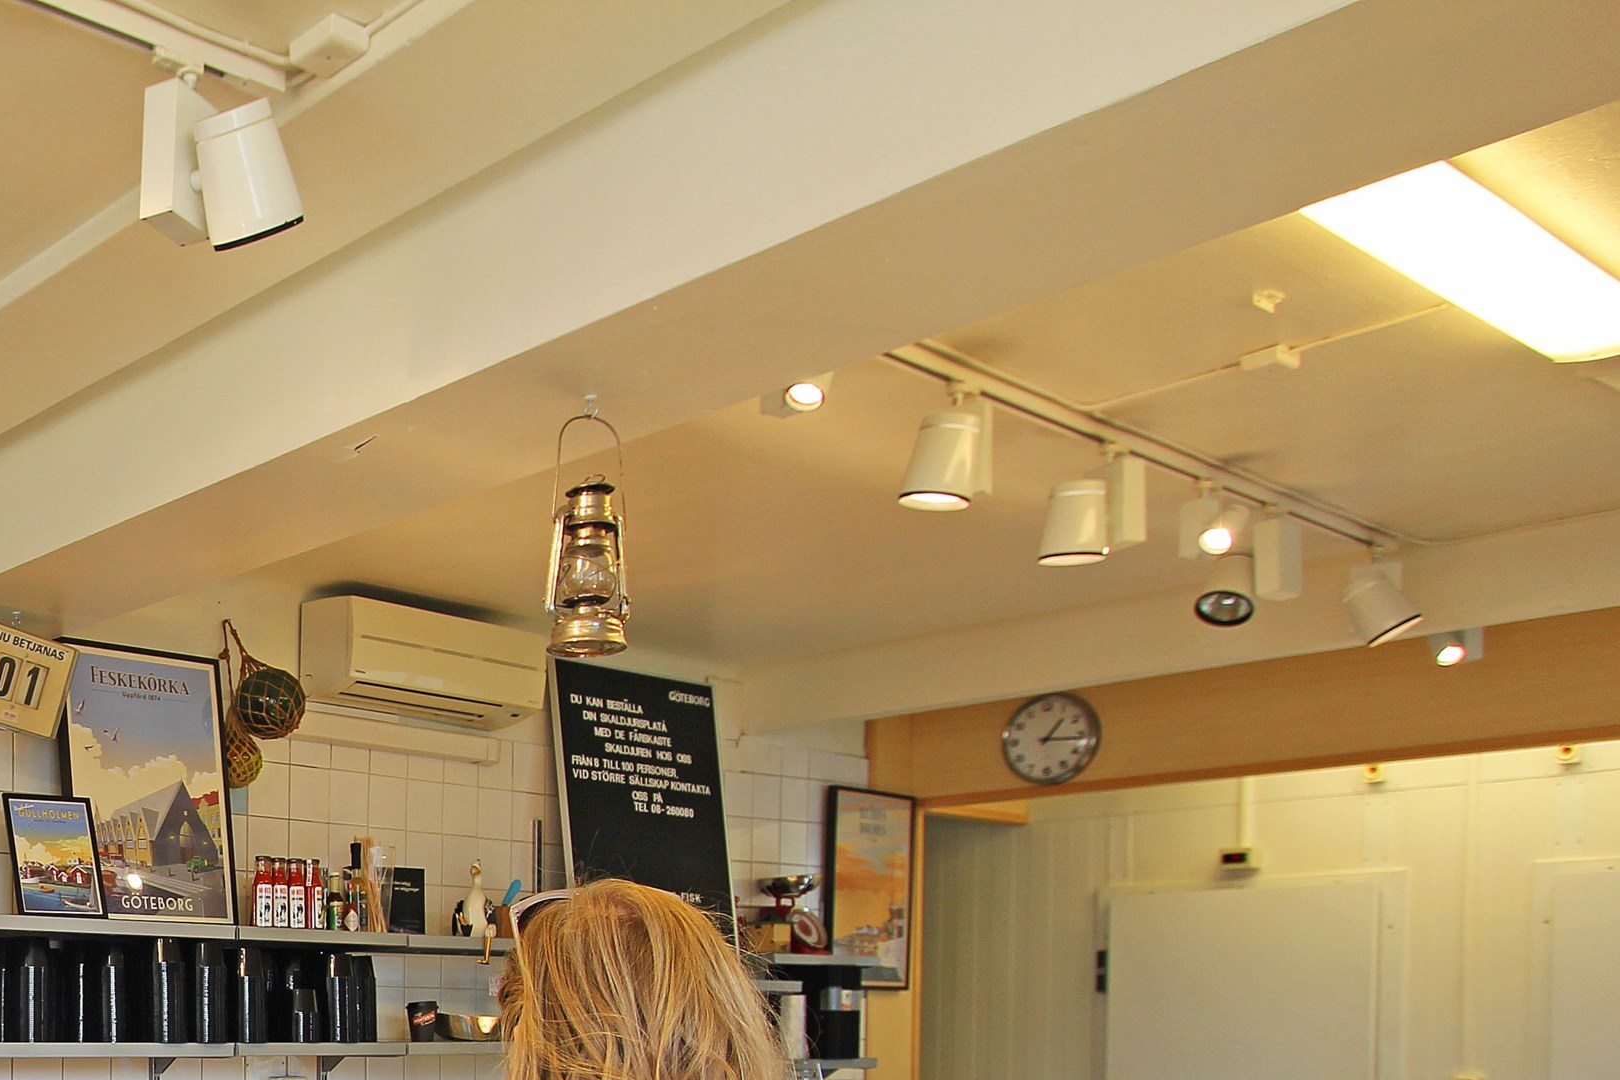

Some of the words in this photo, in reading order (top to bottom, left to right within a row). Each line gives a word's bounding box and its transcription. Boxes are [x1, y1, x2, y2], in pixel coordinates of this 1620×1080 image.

[12, 635, 66, 661] BETJÄNAS
[570, 693, 583, 705] DU
[586, 696, 604, 708] KAN
[606, 698, 644, 714] BESTÄLLA
[668, 690, 711, 707] GÖTEBORG
[582, 710, 597, 721] DIN
[600, 712, 668, 733] SKALDJURSPLATÅ
[594, 726, 612, 738] MED
[614, 729, 626, 741] DE
[629, 729, 672, 748] FÄRSKASTE
[571, 754, 593, 767] FRÅN
[602, 758, 621, 771] TILL
[621, 761, 635, 773] 100
[604, 743, 652, 759] SKALDJUREN
[656, 751, 673, 762] HOS
[676, 753, 692, 765] OSS
[572, 768, 589, 780] VID
[591, 769, 626, 784] STÖRRE
[629, 774, 670, 791] SÄLLSKAP
[670, 782, 711, 796] KONTAKTA
[631, 790, 649, 801] OSS
[653, 791, 664, 803] PÅ
[634, 801, 649, 813] TEL
[121, 892, 194, 912] GÖTEBORG
